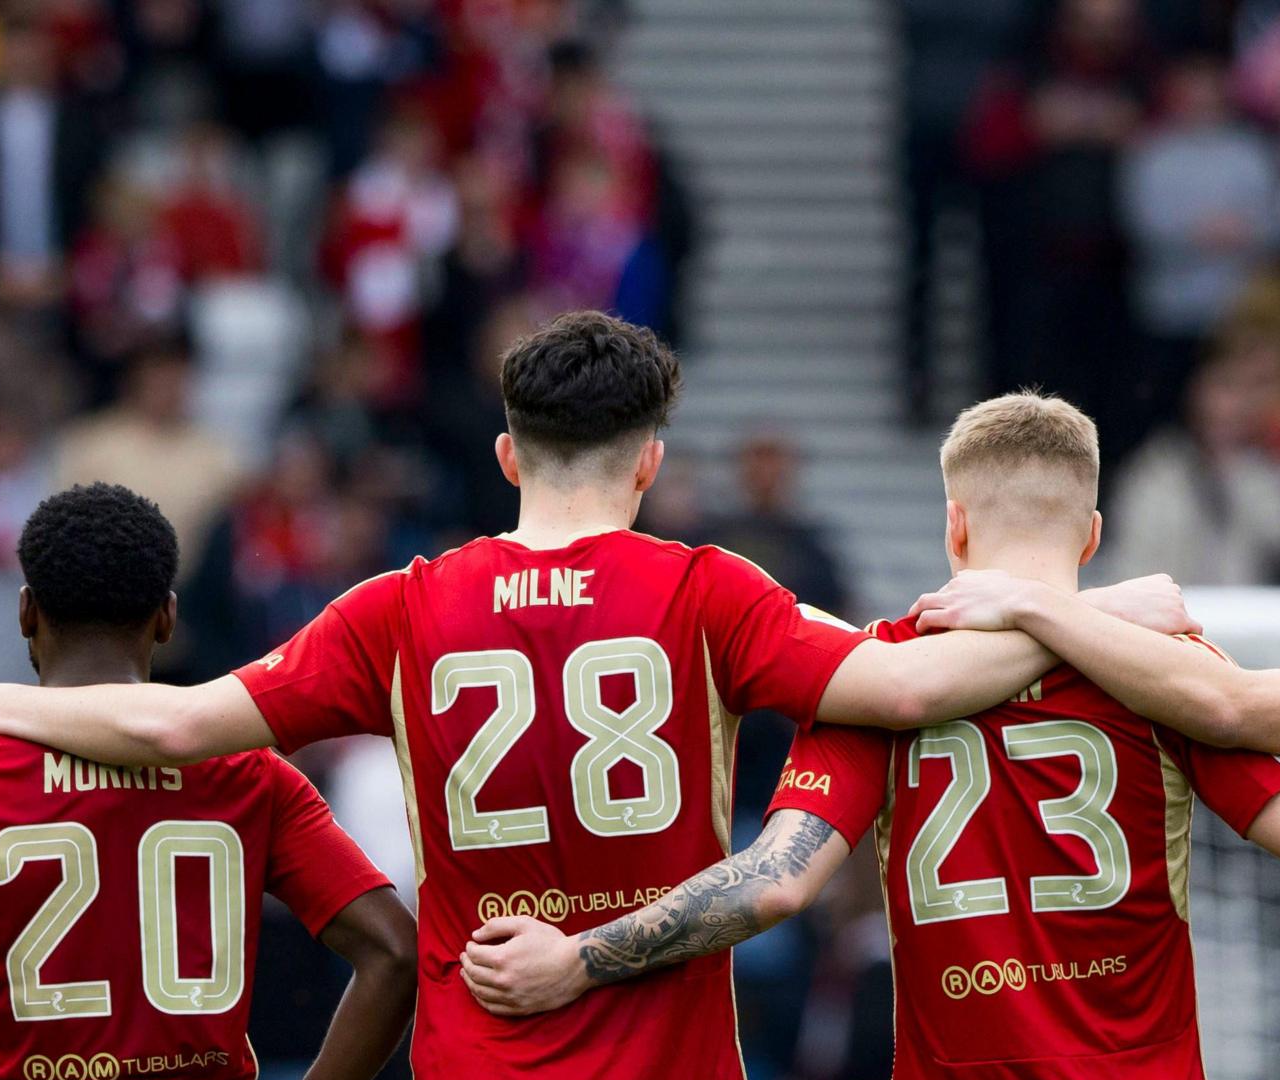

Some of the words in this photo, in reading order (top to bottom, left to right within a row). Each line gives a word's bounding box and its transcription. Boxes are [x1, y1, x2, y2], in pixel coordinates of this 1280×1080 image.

[492, 567, 595, 614] MILNE
[431, 636, 681, 852] 28
[907, 719, 1131, 926] 23
[567, 885, 673, 914] TUBULARS
[942, 958, 1026, 1000] RAM
[1027, 955, 1127, 983] TUBULARS
[122, 1051, 229, 1076] TUBULARS
